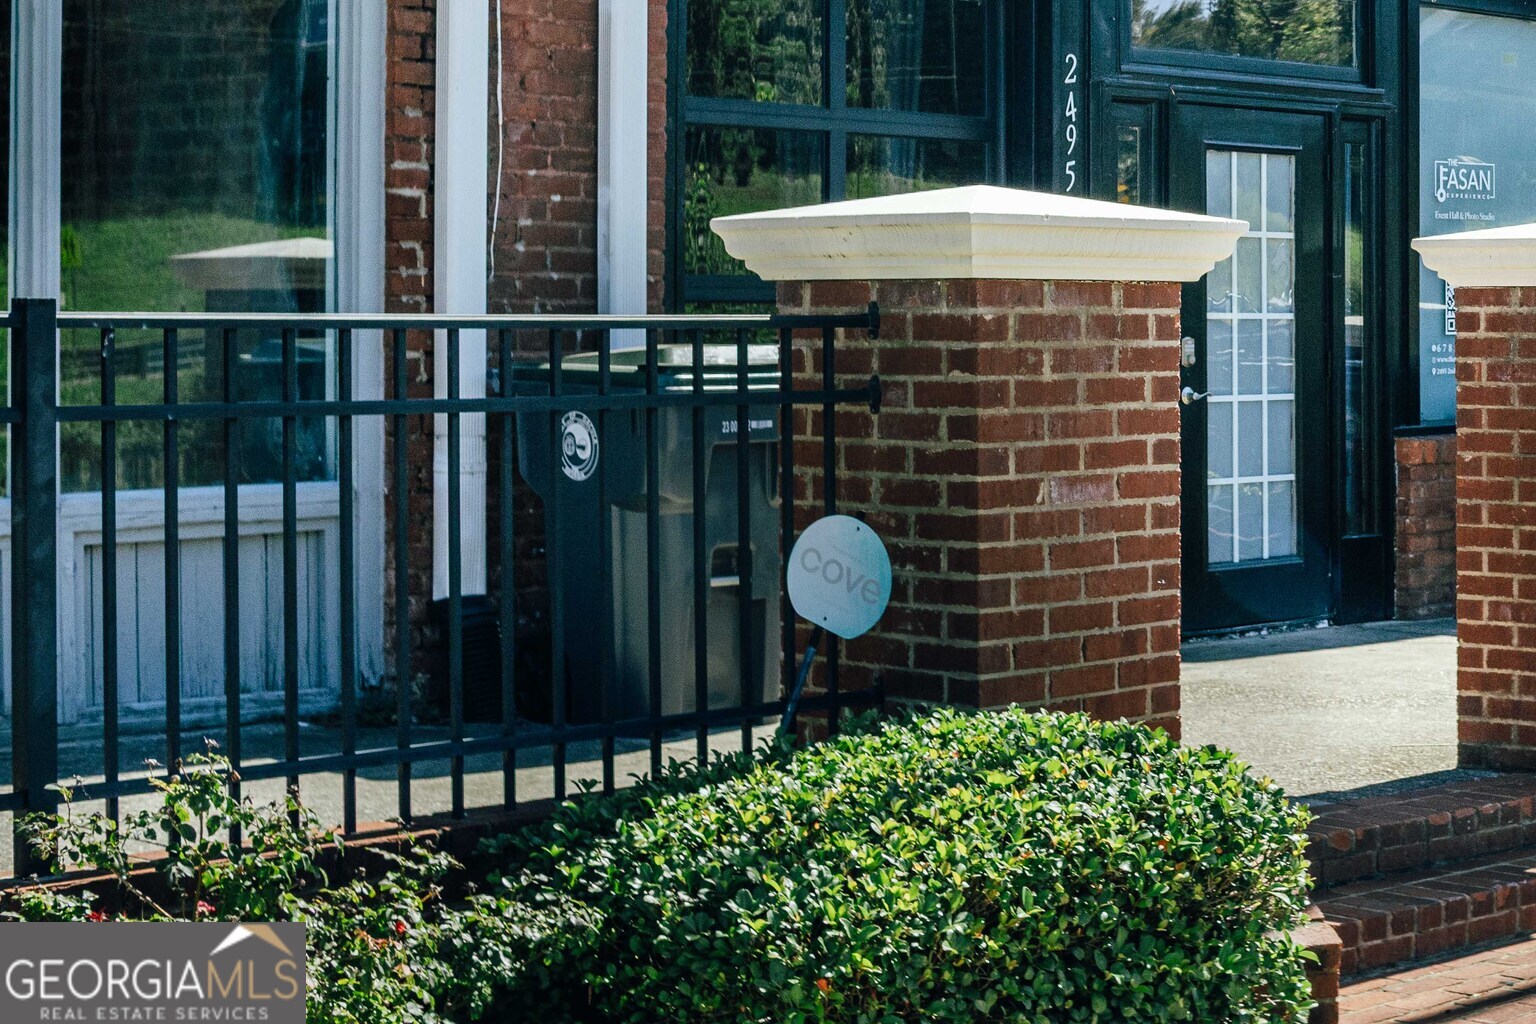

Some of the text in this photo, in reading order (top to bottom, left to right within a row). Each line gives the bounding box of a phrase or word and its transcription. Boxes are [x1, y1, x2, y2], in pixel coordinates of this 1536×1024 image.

[1064, 53, 1077, 192] 2495
[1448, 158, 1459, 167] THE
[1438, 165, 1491, 197] FASAN
[1446, 192, 1490, 200] EXPERIENCE
